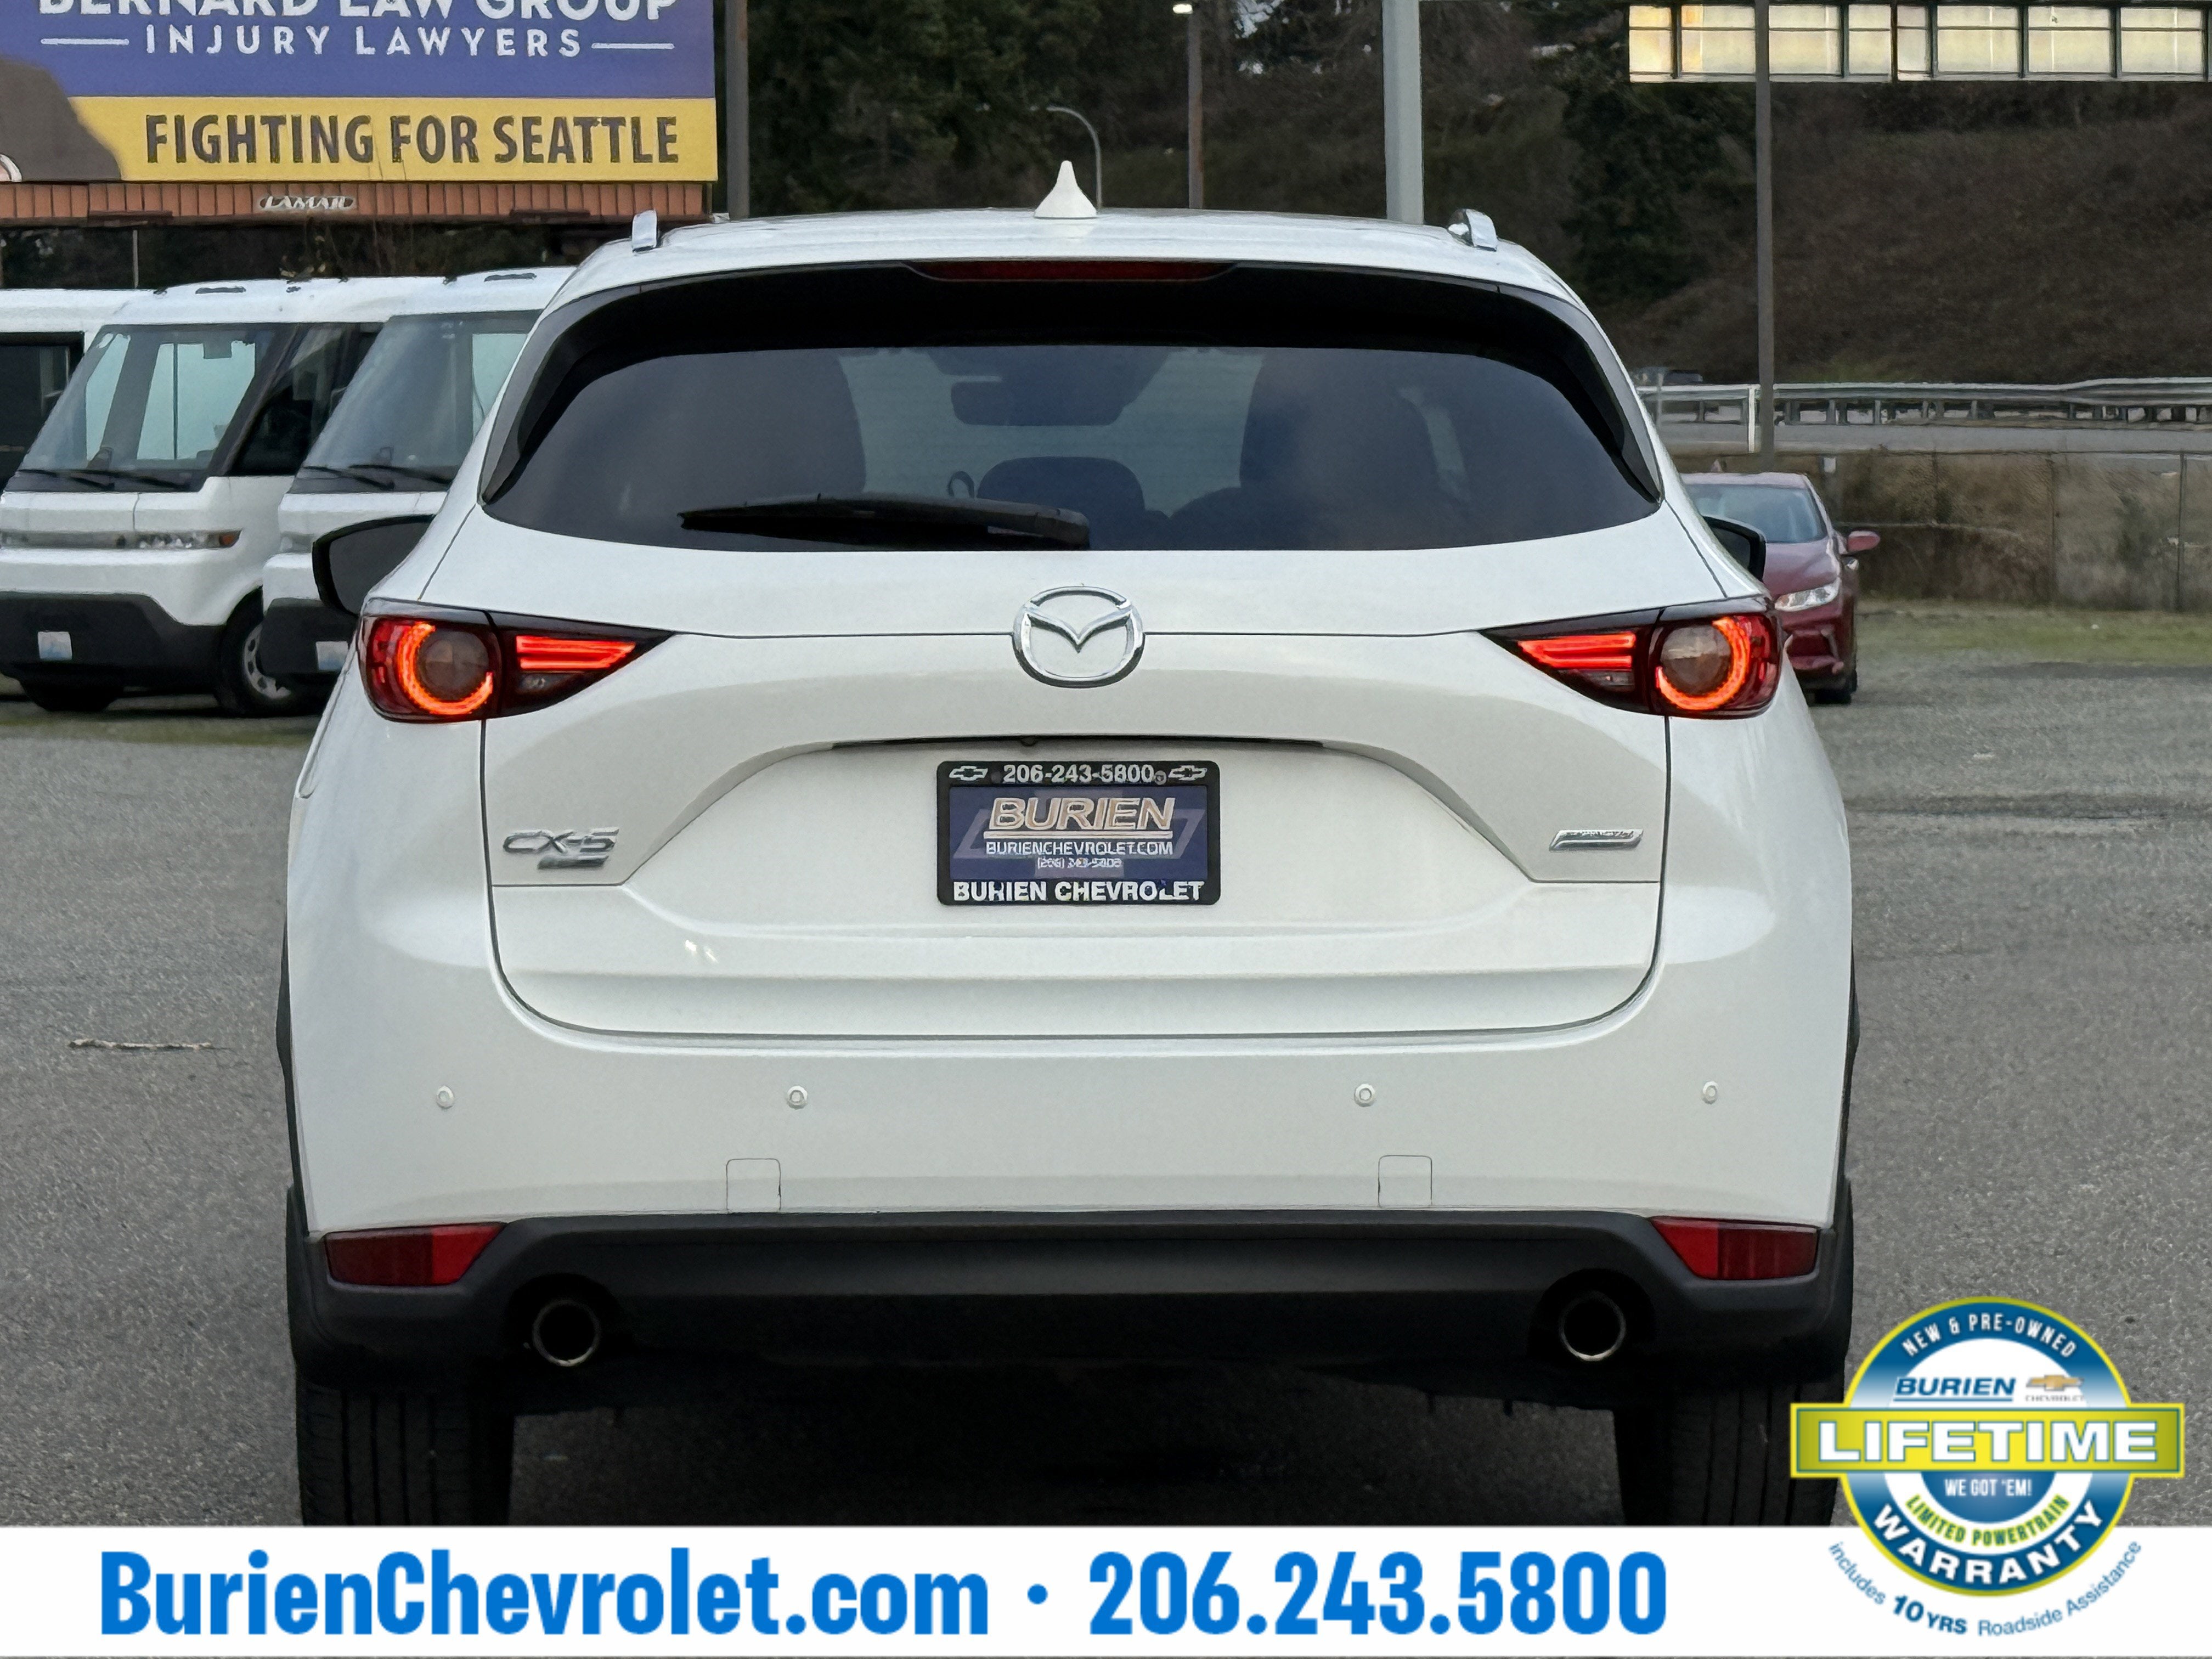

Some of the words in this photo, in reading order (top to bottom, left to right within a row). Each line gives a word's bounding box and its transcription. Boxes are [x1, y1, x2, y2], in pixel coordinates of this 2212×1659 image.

[146, 24, 330, 55] INJURY
[356, 26, 580, 57] LAWYERS
[145, 115, 373, 163] FIGHTING
[390, 115, 479, 163] FOR
[493, 116, 679, 163] SEATTLE
[1003, 764, 1154, 783] 206-243-5800
[989, 797, 1176, 830] BURIEN
[1054, 881, 1205, 901] CHEVROLET
